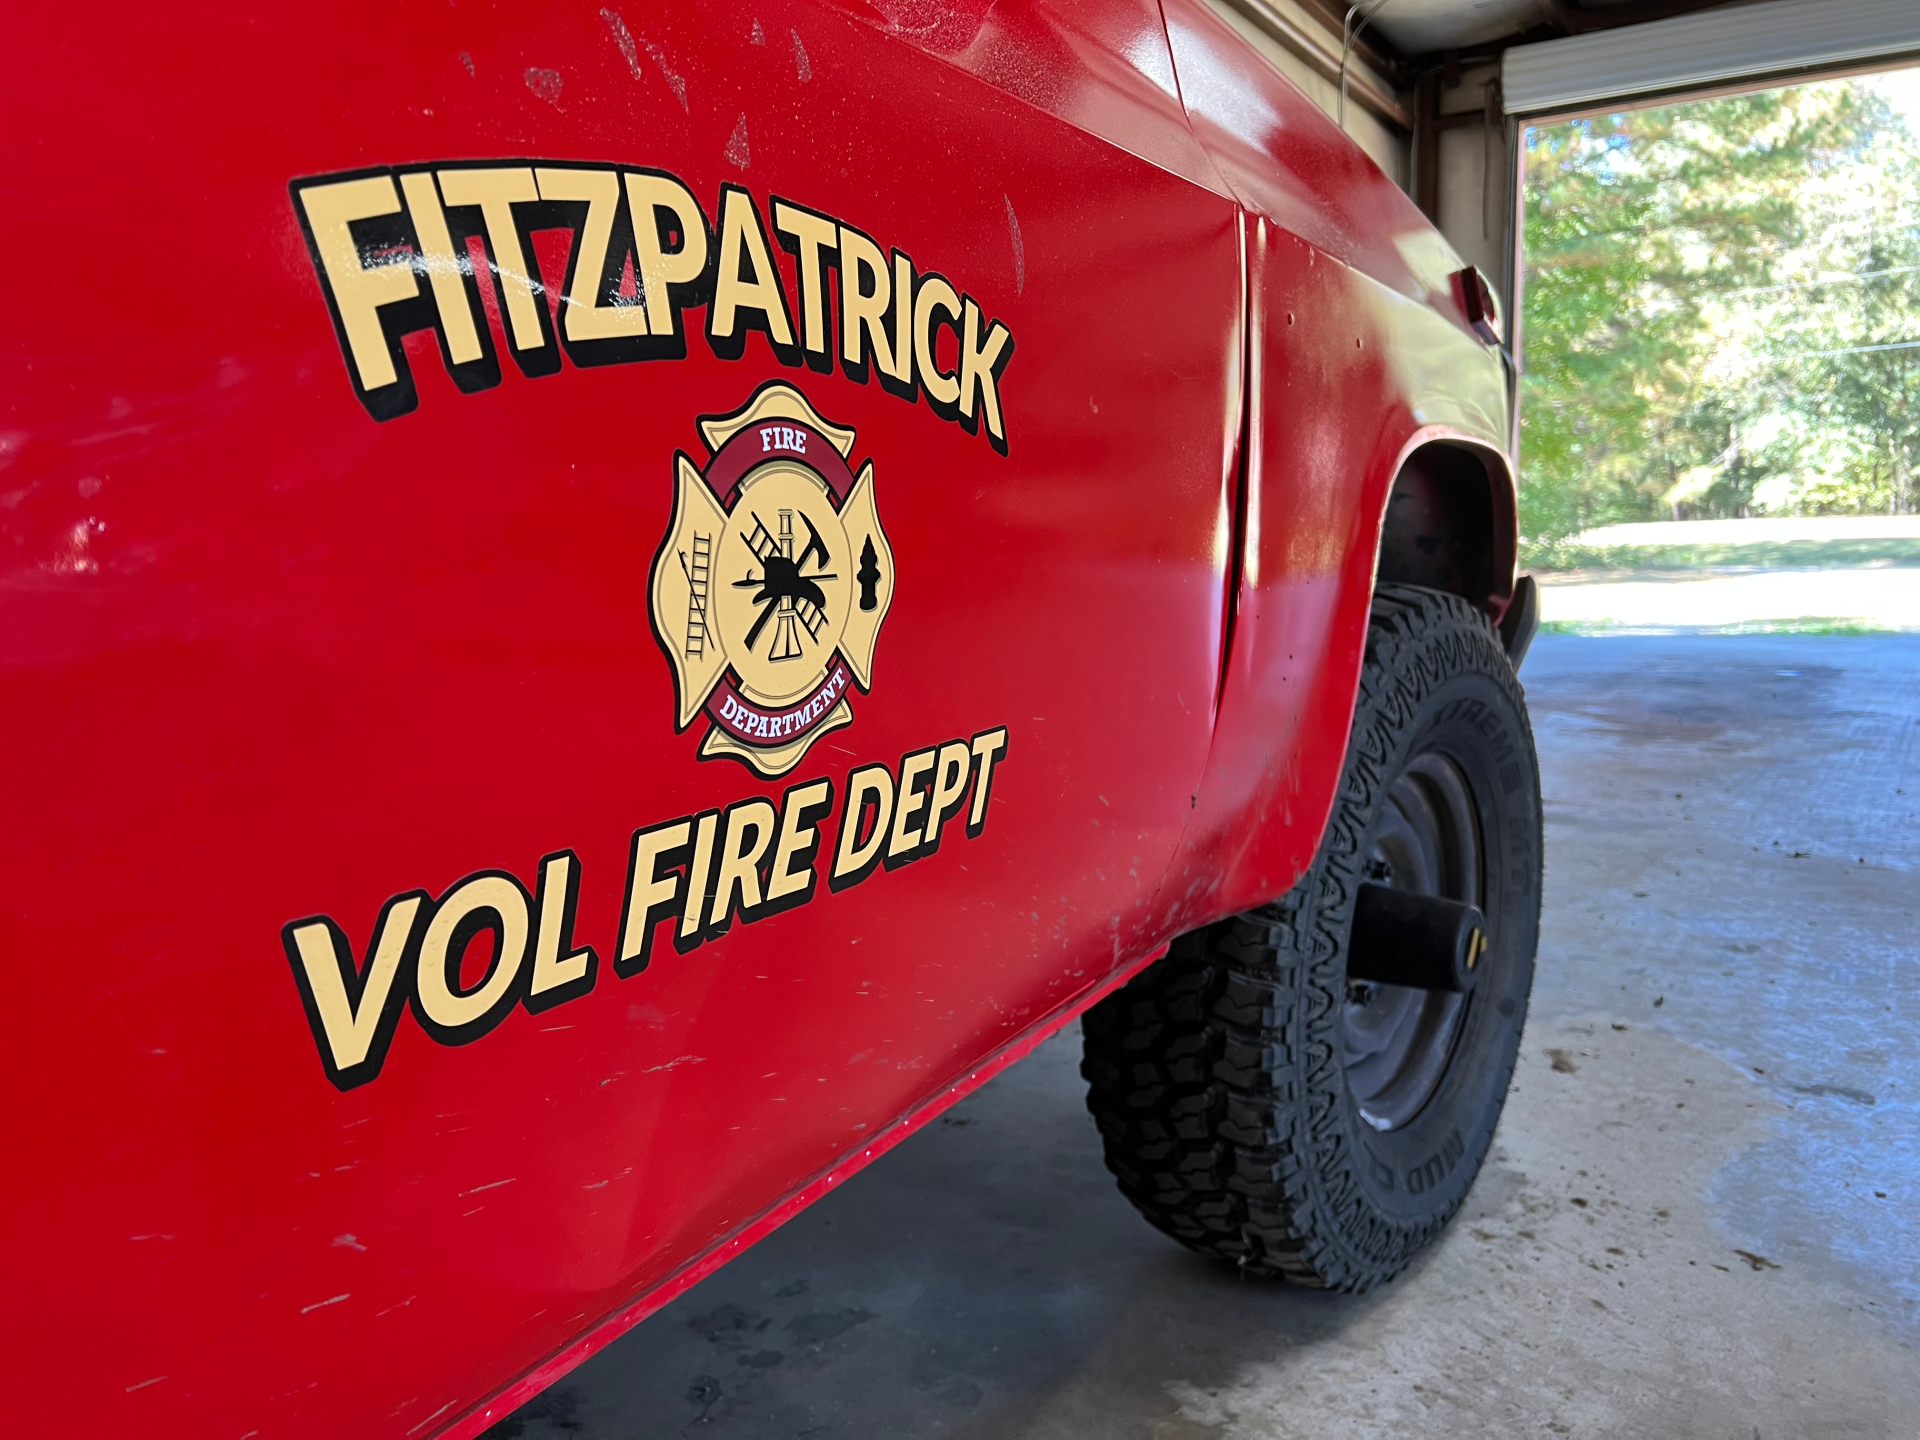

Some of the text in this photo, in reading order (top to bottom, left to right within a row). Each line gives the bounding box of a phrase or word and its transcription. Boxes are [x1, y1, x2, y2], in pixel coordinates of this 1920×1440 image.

[293, 161, 1012, 448] FITZPATRICK
[759, 426, 807, 455] FIRE
[719, 666, 846, 738] DEPARTMENT
[1412, 697, 1523, 796] XTREME
[286, 727, 1007, 1082] VOL FIRE DEPT
[1407, 1128, 1465, 1196] MUD
